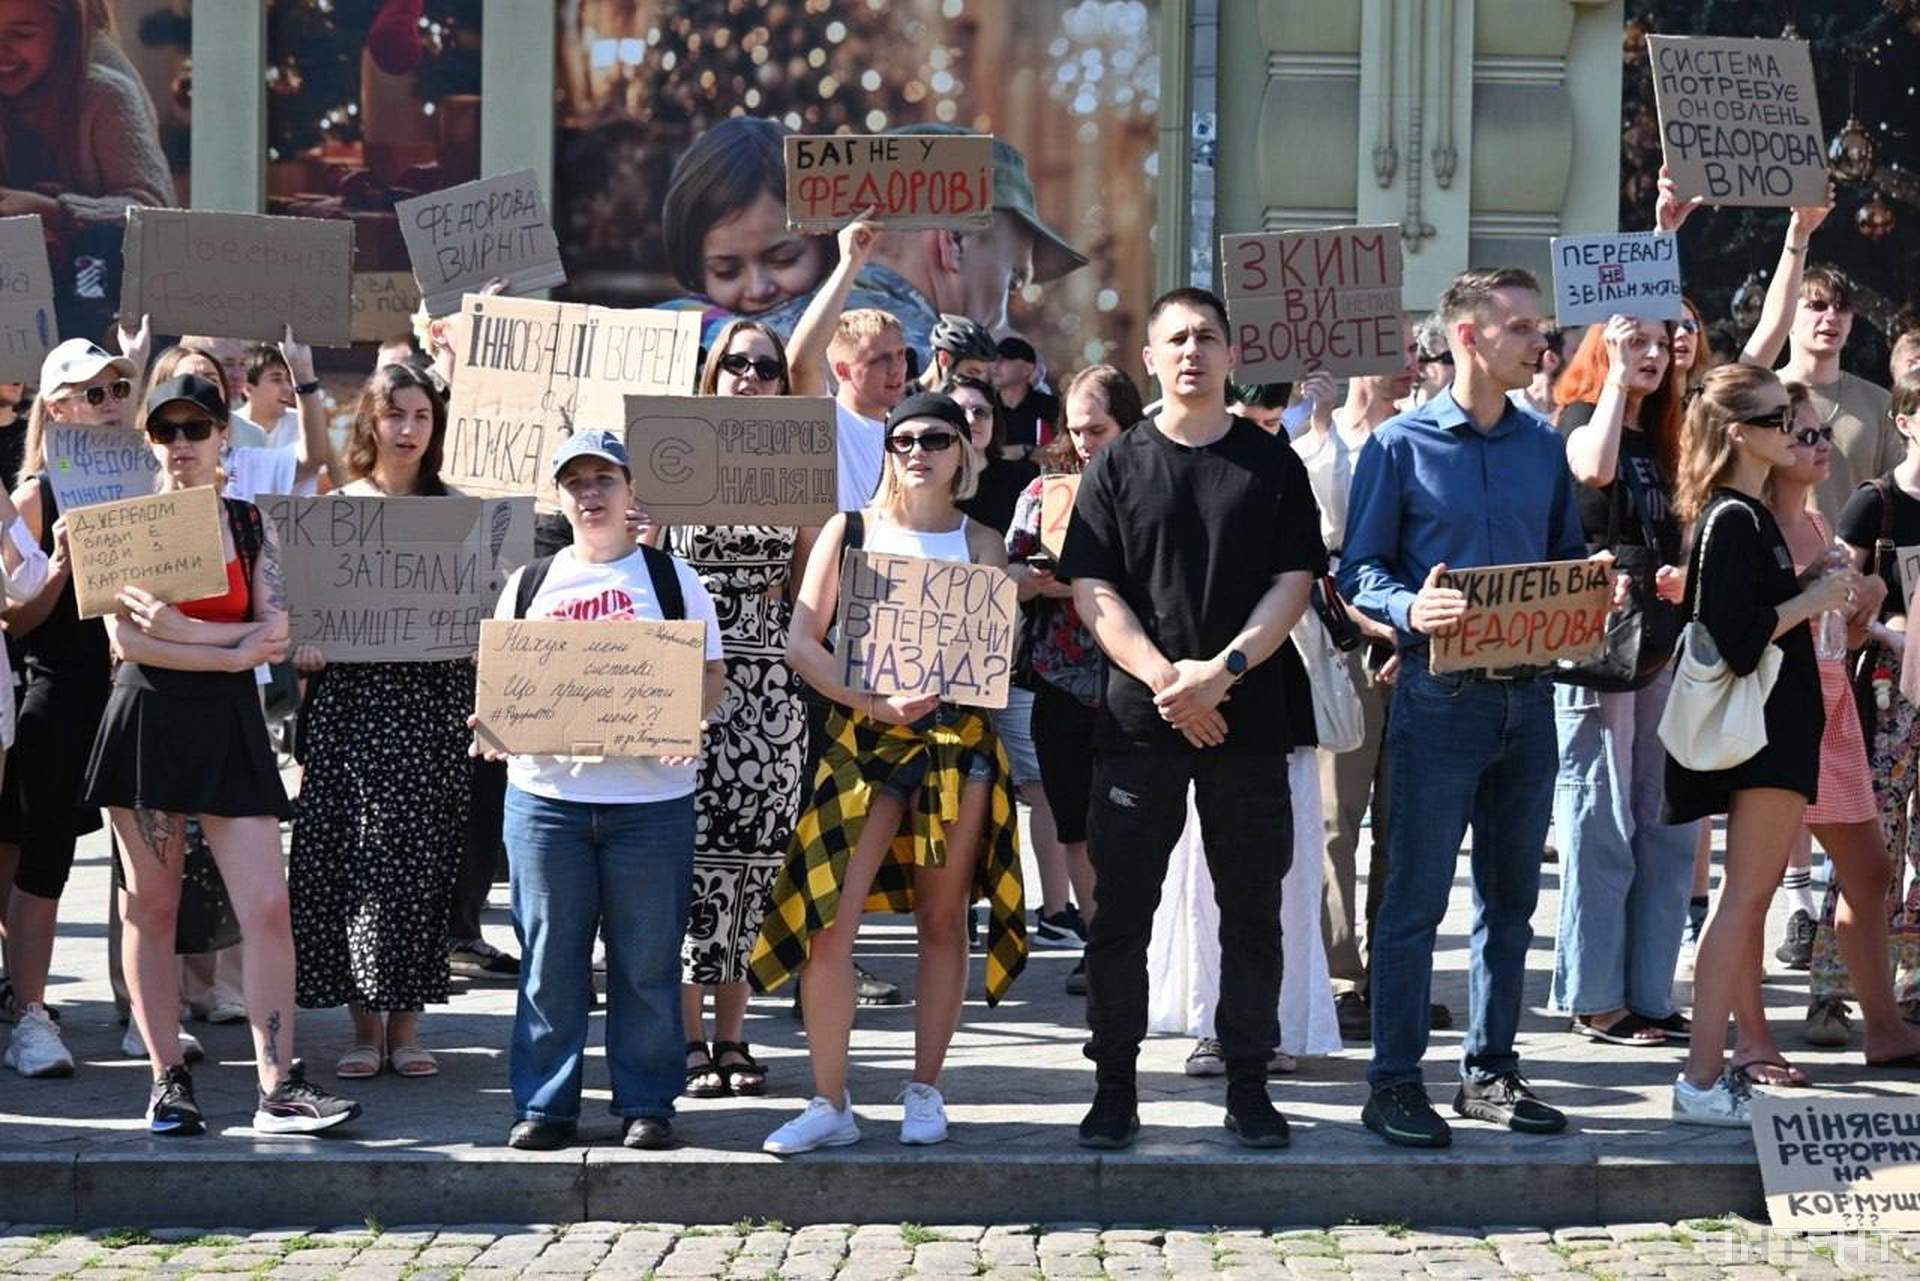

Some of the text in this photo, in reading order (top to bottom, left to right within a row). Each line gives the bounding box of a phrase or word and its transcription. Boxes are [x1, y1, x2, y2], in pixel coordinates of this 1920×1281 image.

[1659, 48, 1781, 77] СИСТЕМА
[1662, 75, 1798, 101] ПОТРЕБУЄ
[1679, 98, 1809, 125] ОНОВЛЕНЬ
[797, 138, 936, 169] БАГ НЕ У
[1666, 121, 1824, 168] ФЕДОРОВА
[415, 189, 537, 244] ФЕДОРОВА
[1563, 239, 1673, 267] ПЕРЕВАГУ
[1601, 269, 1624, 283] НЕ
[1284, 286, 1338, 323] ВИ
[1239, 315, 1399, 365] ВОЮЄТЕ
[718, 418, 833, 456] ФЕДОРОВ
[74, 447, 162, 476] ФЕДОРО
[267, 500, 386, 549] ЯК ВИ
[852, 557, 1010, 622] ЦЕ КРОК
[1508, 565, 1561, 603] ГЕТЬ
[427, 605, 490, 647] ФЕД
[844, 602, 1011, 654] ВПЕРЕД ЧИ
[1435, 608, 1604, 658] ФЕДОРОВА
[843, 640, 1009, 698] НАЗАД?
[1832, 1165, 1873, 1182] НА
[1787, 1192, 1920, 1217] КОРМУШ
